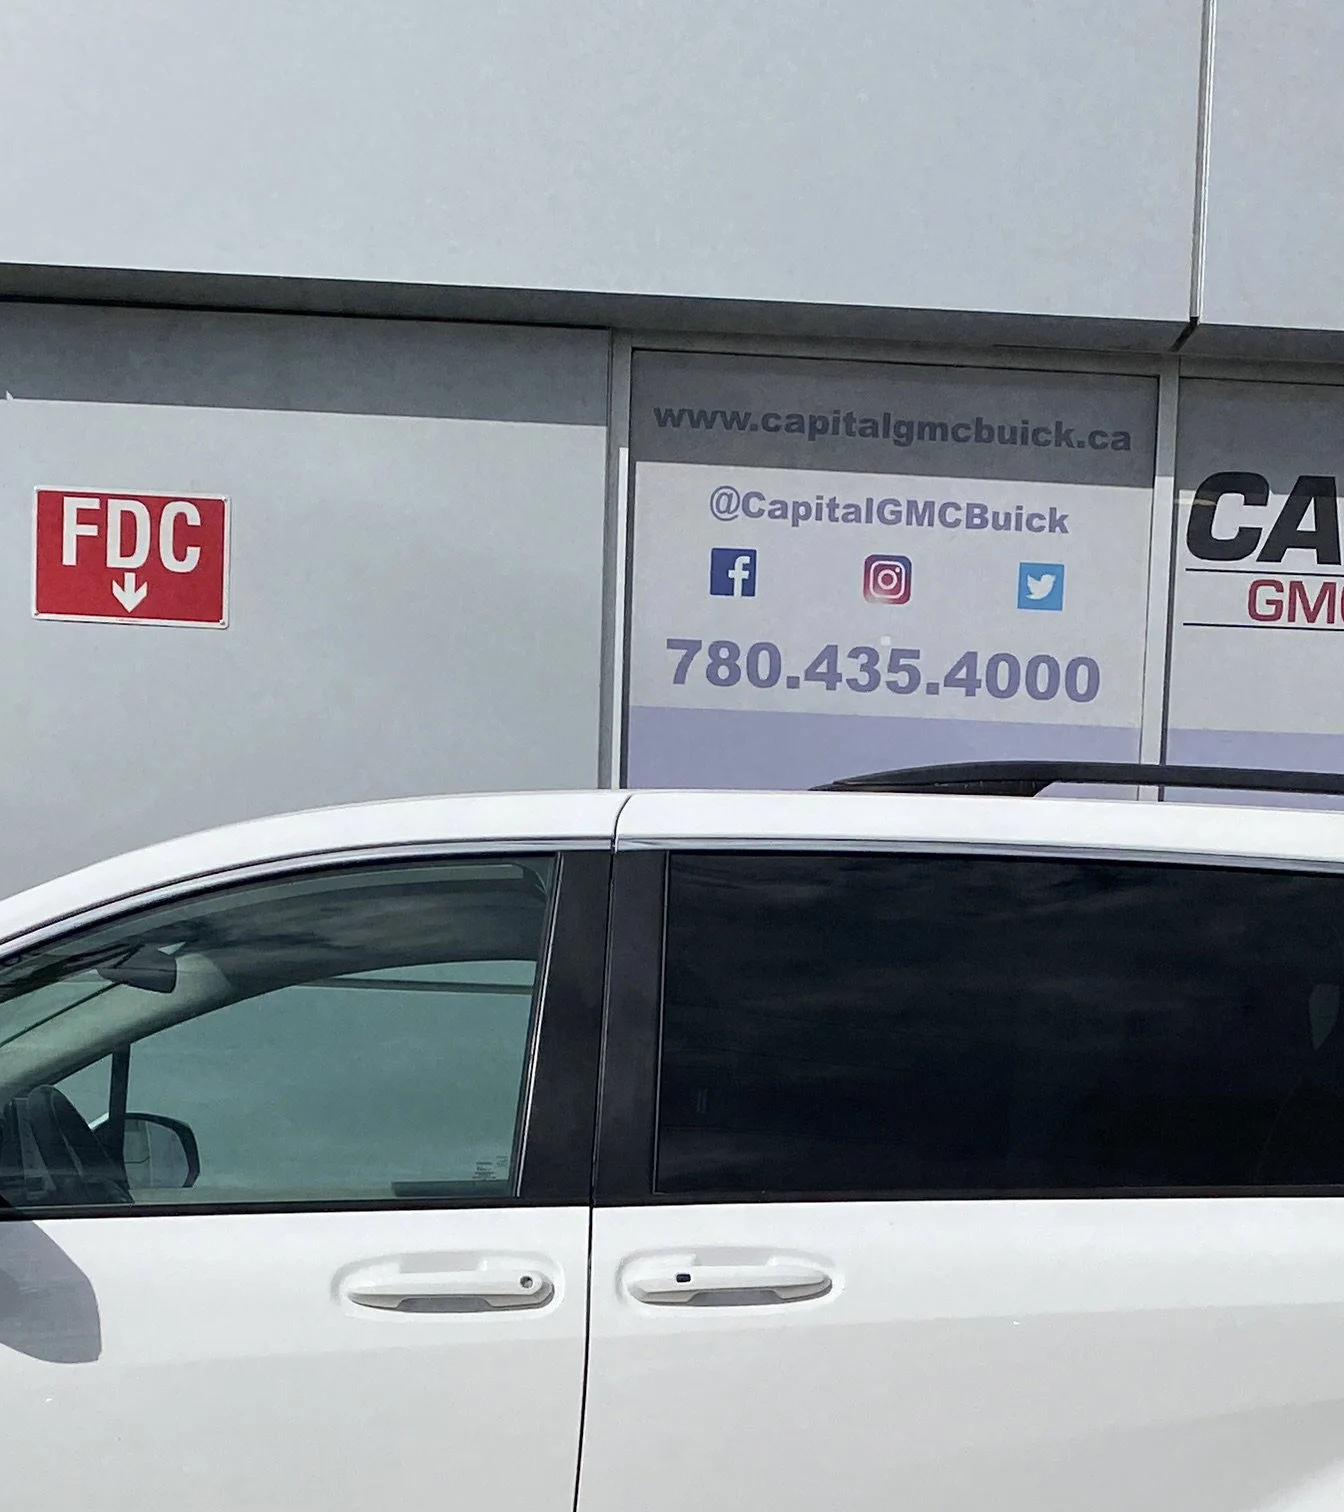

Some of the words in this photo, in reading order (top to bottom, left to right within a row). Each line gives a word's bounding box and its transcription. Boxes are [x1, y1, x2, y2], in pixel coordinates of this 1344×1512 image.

[653, 406, 1132, 452] www.capitalgmcbuick.ca
[61, 495, 202, 573] FDC
[709, 484, 1070, 534] @CapitalGMCBuick
[665, 638, 1102, 703] 780.435.4000
